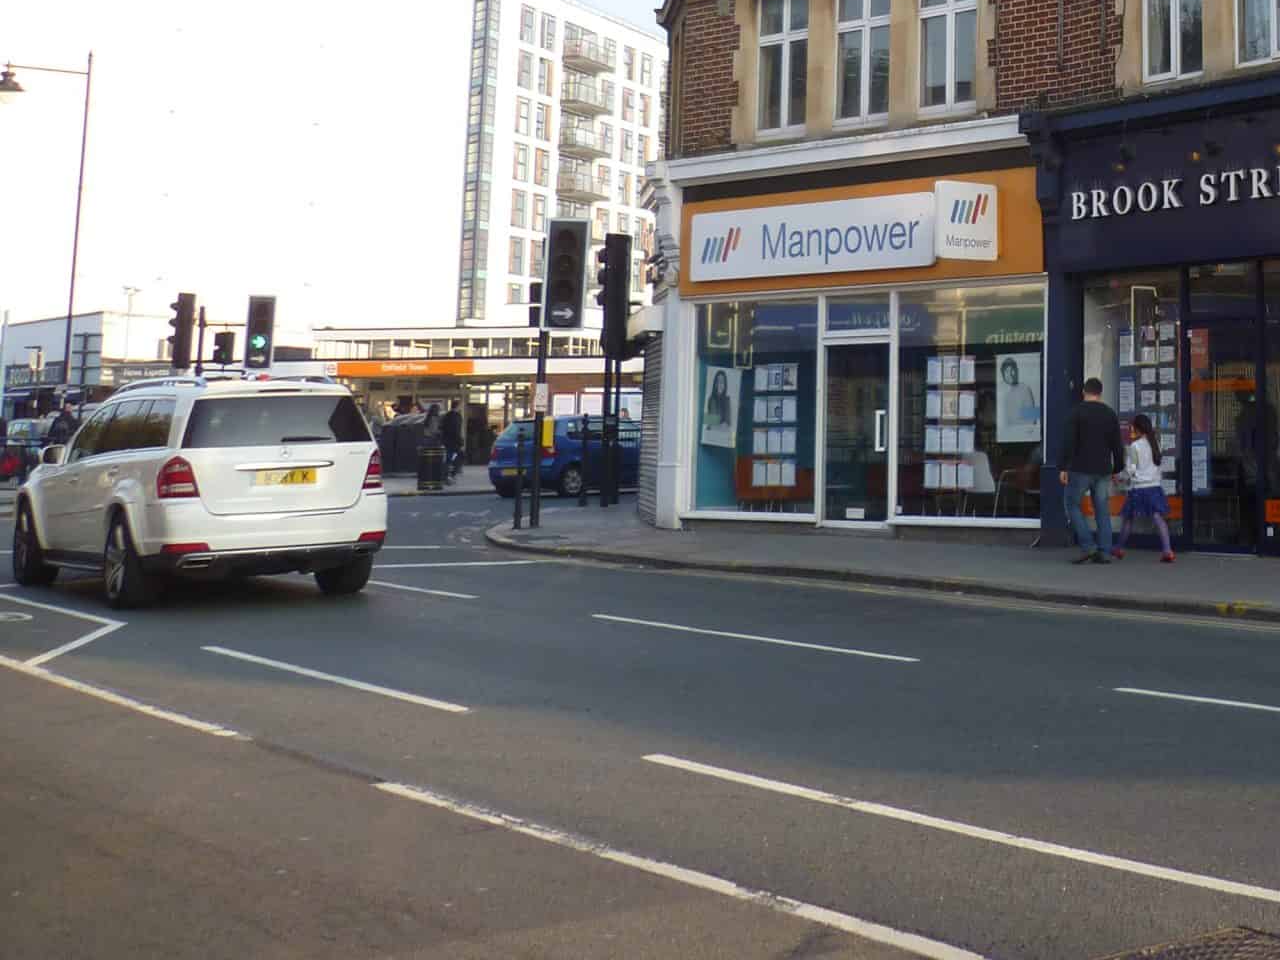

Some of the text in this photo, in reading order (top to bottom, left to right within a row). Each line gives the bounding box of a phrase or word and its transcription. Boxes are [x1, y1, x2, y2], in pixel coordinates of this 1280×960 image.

[1071, 179, 1183, 220] BROOK
[762, 219, 920, 264] Manpower
[945, 234, 993, 249] Manpower
